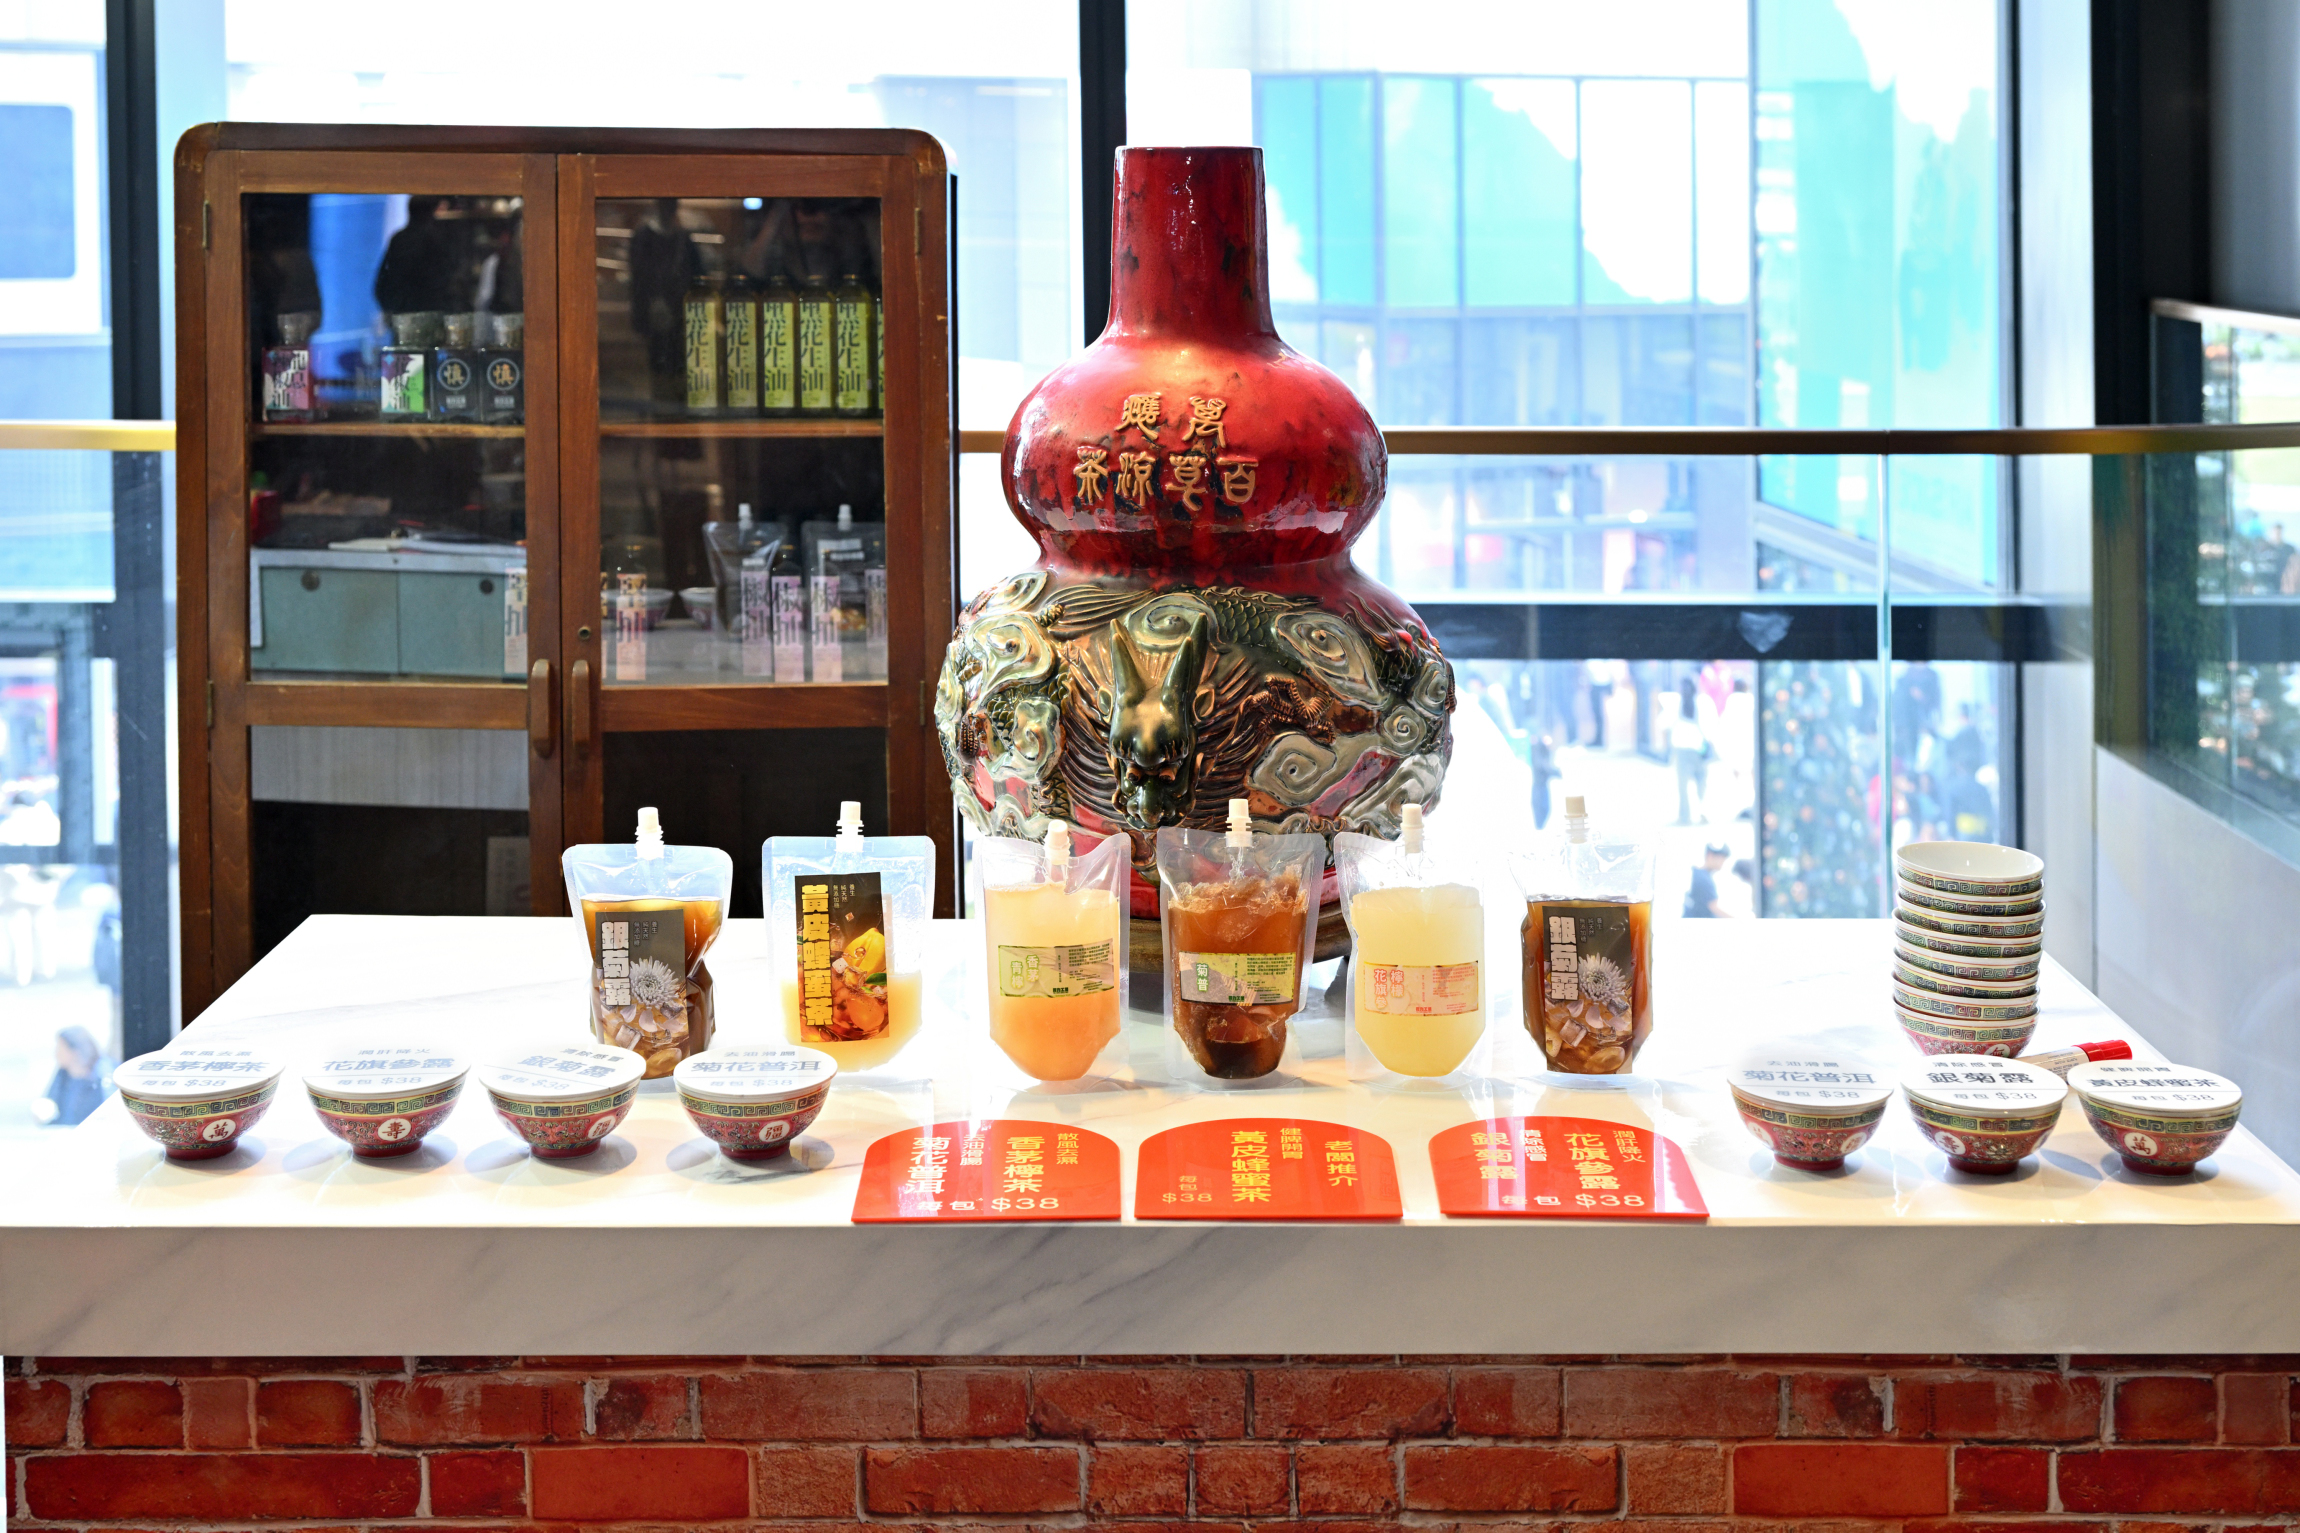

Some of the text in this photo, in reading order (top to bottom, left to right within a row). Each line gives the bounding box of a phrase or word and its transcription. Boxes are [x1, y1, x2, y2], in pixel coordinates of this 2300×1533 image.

[1072, 446, 1259, 511] 百草涼茶
[601, 921, 631, 1006] 銀菊露
[802, 884, 834, 1026] 黃皮蜂蜜茶
[1549, 916, 1579, 1001] 銀菊露
[1026, 955, 1039, 982] 香茅
[1196, 963, 1209, 991] 菊普
[1390, 969, 1404, 998] 檸檬
[137, 1060, 270, 1073] 香茅檸茶
[322, 1057, 456, 1071] 花旗參露
[517, 1055, 617, 1079] 銀菊露
[691, 1060, 821, 1072] 菊花普洱
[184, 1078, 227, 1088] $38
[381, 1076, 422, 1086] $38
[531, 1078, 570, 1091] $38
[752, 1078, 793, 1088] $38
[1742, 1070, 1877, 1084] 菊花普洱
[1926, 1072, 2035, 1084] 銀菊露
[2086, 1078, 2222, 1088] 黃皮蜂蜜茶
[1818, 1090, 1860, 1099] $38
[1996, 1092, 2038, 1101] $38
[208, 1122, 230, 1140] 萬
[381, 1122, 406, 1140] 壽
[959, 1134, 986, 1166] 去油滑腸
[1280, 1128, 1304, 1159] 健脾開胃
[1520, 1129, 1548, 1162] 清除感冒
[1612, 1130, 1646, 1163] 潤肝降火
[903, 1136, 952, 1194] 菊花普洱
[1002, 1136, 1046, 1193] 香茅檸茶
[1231, 1131, 1271, 1202] 黃皮蜂蜜茶
[1325, 1141, 1358, 1187] 老闆推介
[1470, 1132, 1520, 1180] 銀菊露
[1563, 1133, 1621, 1190] 花旗參露
[1178, 1175, 1198, 1191] 每包
[916, 1197, 1060, 1212] 每包 $38
[1162, 1192, 1212, 1204] $38
[1501, 1193, 1645, 1209] 每包 $38
